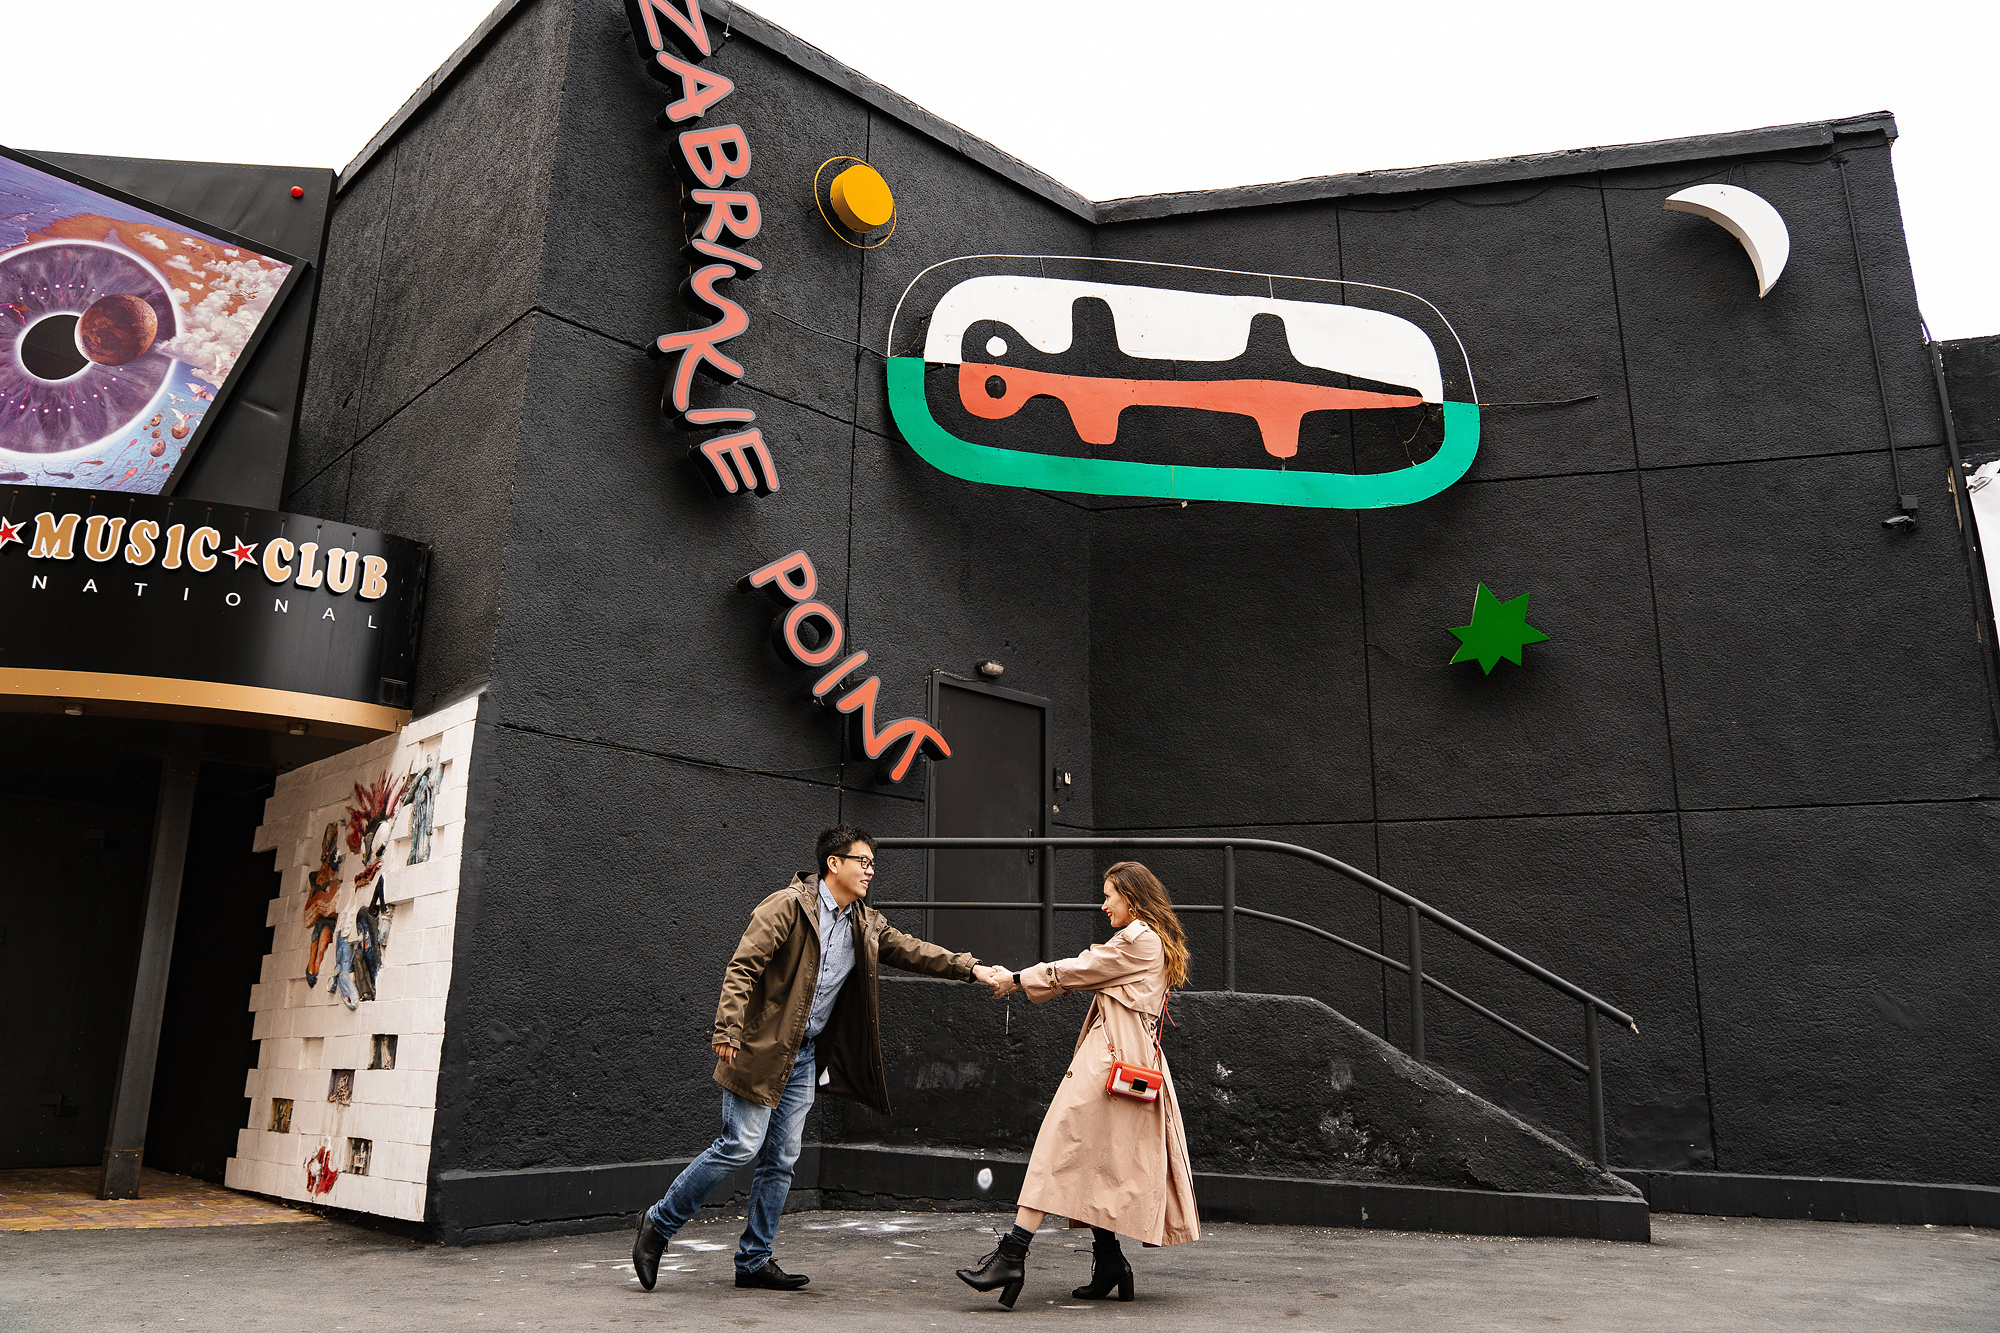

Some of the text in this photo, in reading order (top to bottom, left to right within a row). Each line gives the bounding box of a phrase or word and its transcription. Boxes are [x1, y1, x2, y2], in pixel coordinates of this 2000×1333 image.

[28, 512, 389, 599] MUSIC CLUB
[32, 575, 378, 629] NATIONAL
[749, 549, 953, 783] POINT
